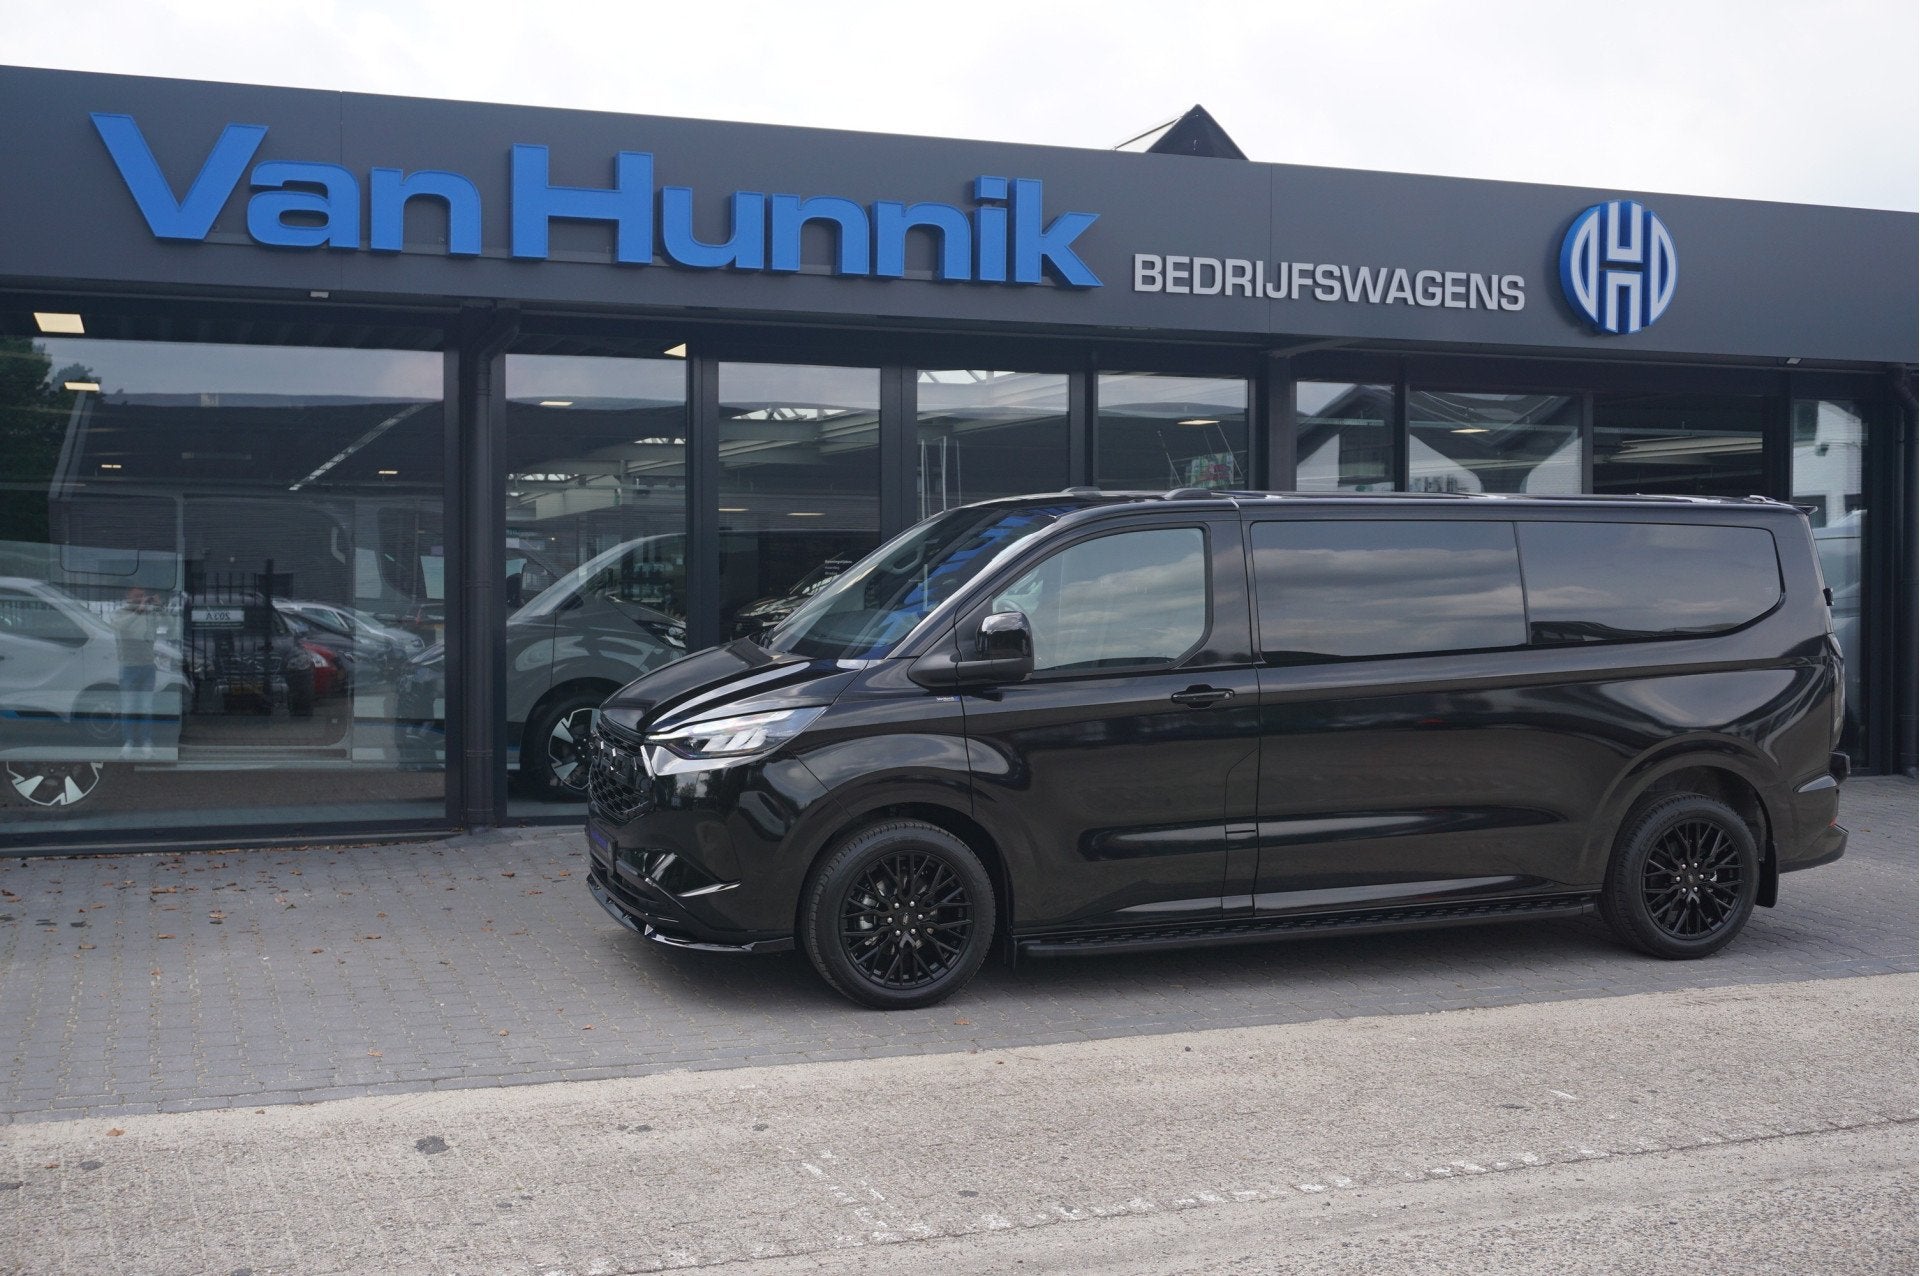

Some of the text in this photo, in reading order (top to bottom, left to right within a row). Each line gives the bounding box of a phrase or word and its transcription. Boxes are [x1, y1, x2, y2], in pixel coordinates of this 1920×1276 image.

[90, 112, 1104, 288] Van Hunnik
[1133, 253, 1525, 312] BEDRIJFSWAGENS
